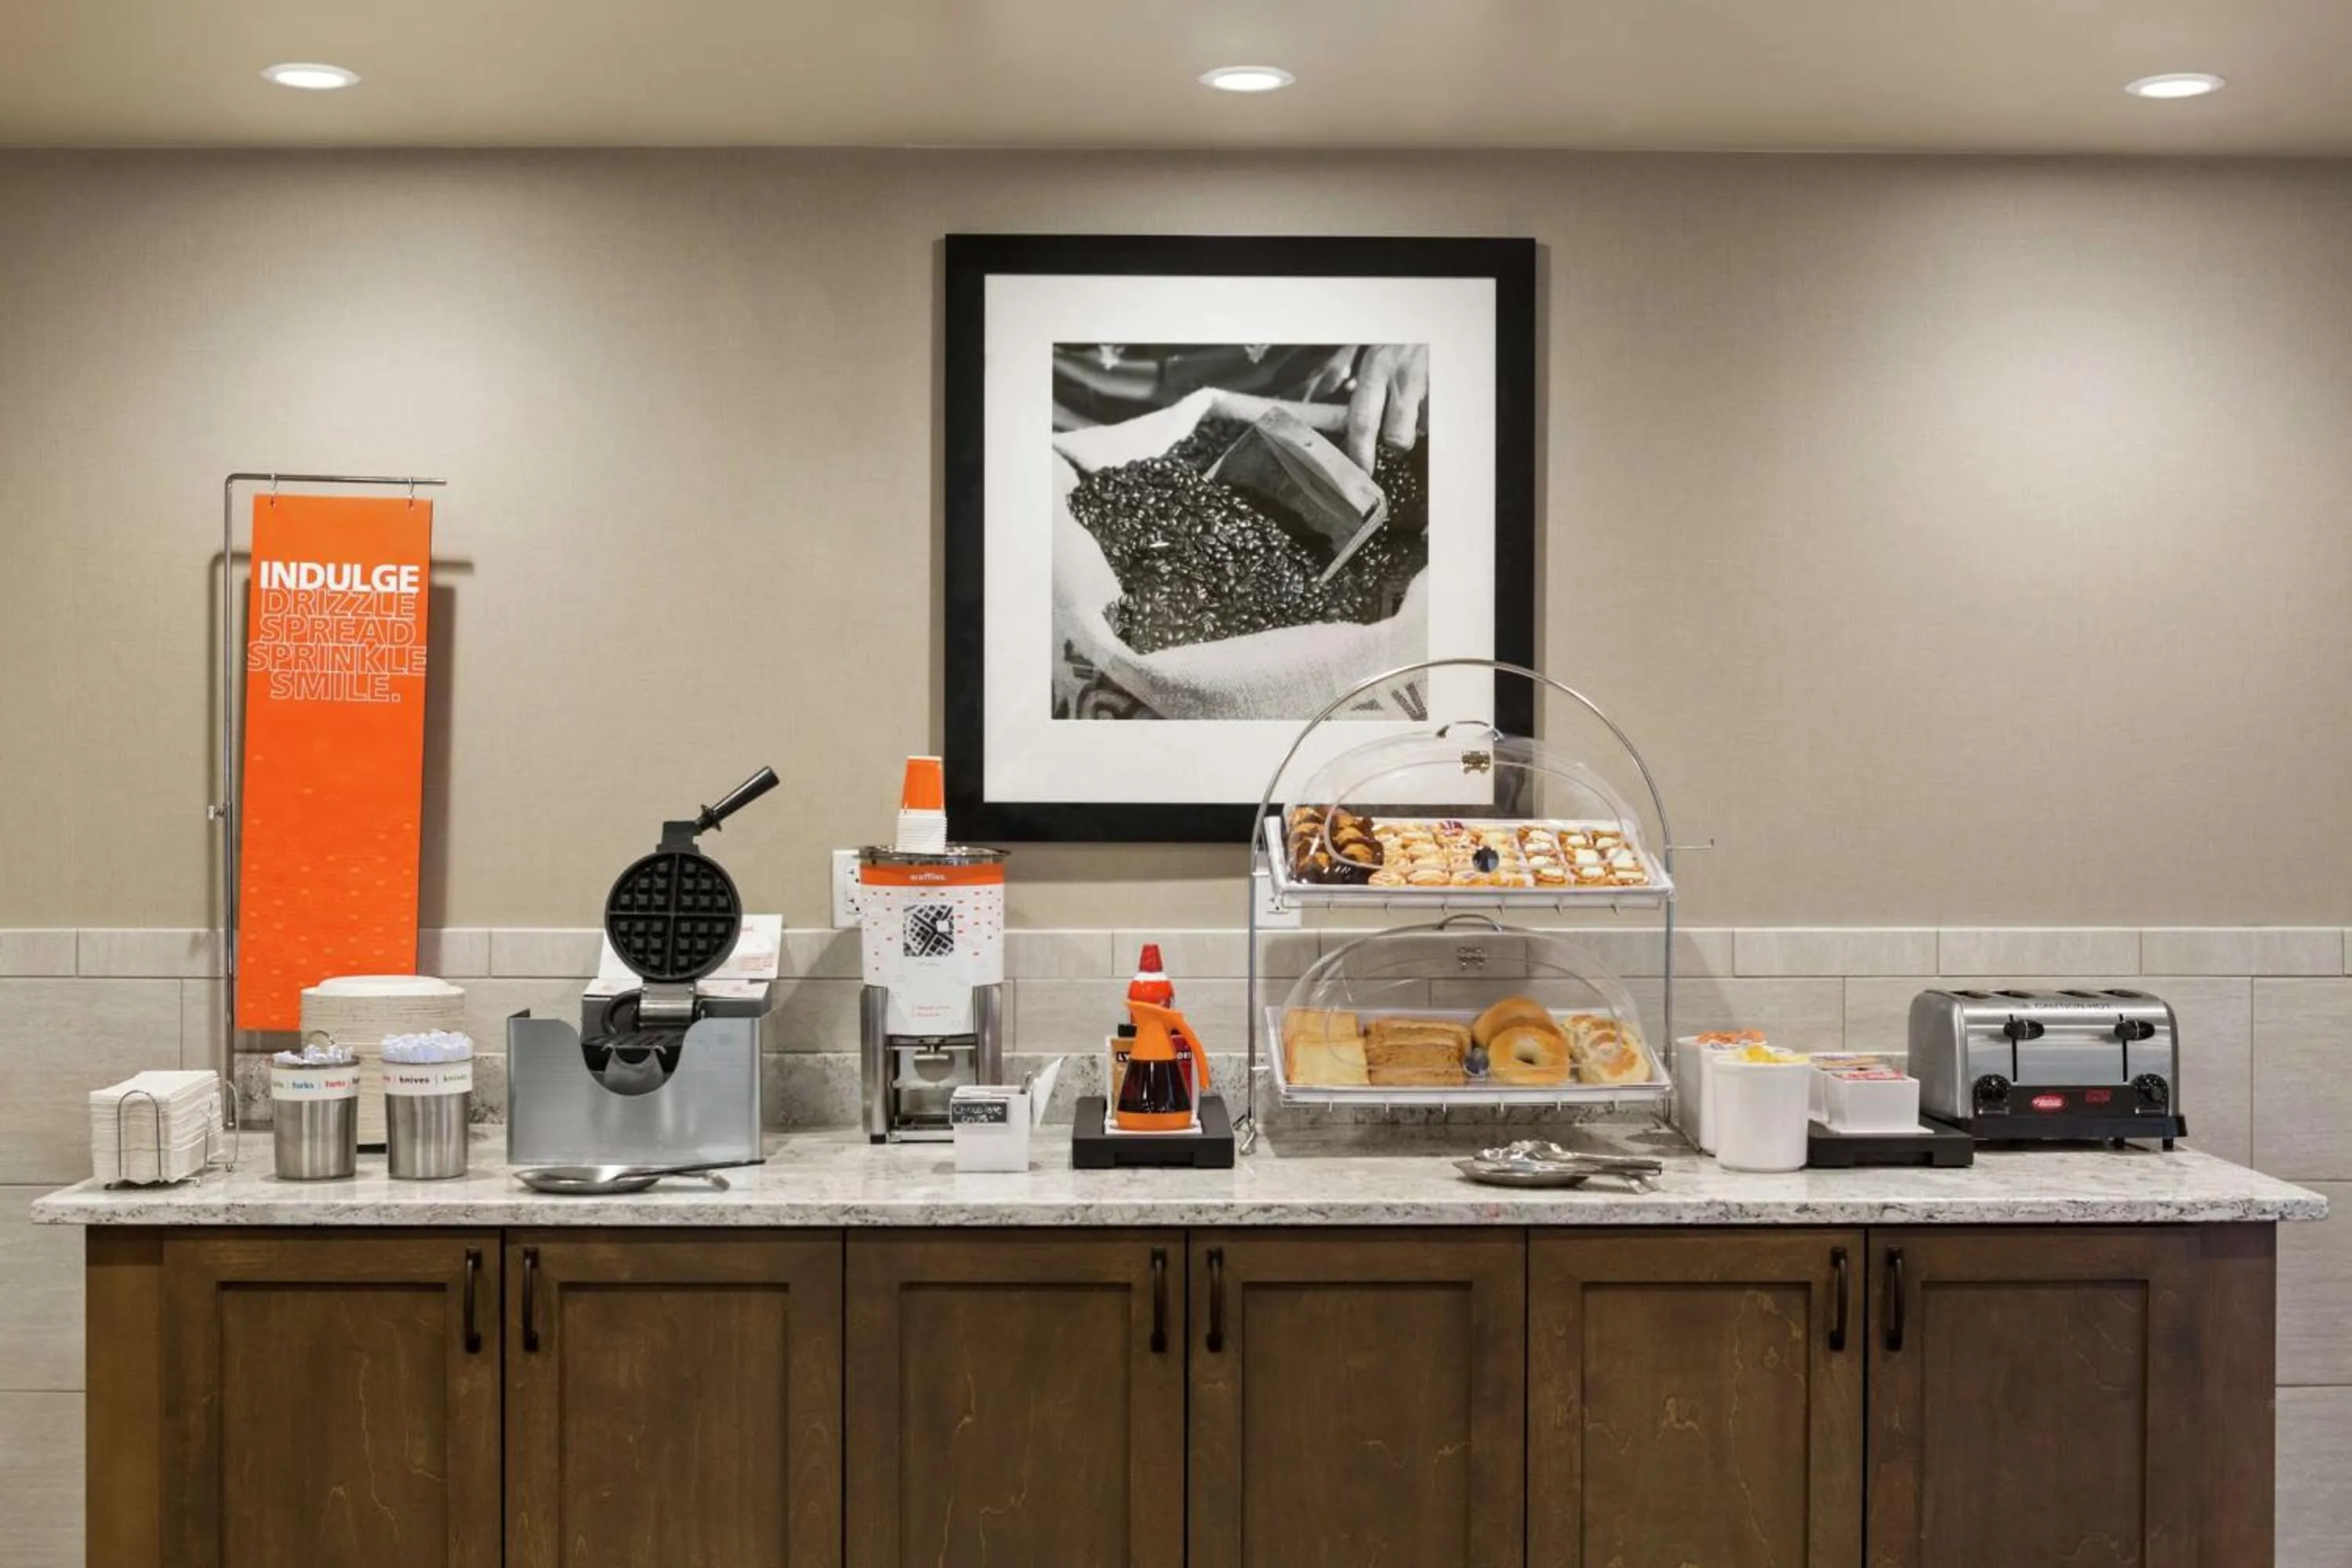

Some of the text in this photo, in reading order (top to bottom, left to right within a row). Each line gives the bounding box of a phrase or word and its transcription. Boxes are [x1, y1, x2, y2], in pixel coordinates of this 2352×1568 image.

[260, 561, 420, 593] INDULGE
[261, 588, 416, 619] DRIZZLE
[260, 614, 416, 647] SPREAD
[247, 641, 427, 676] SPRINKLE
[270, 670, 401, 702] SMILE.
